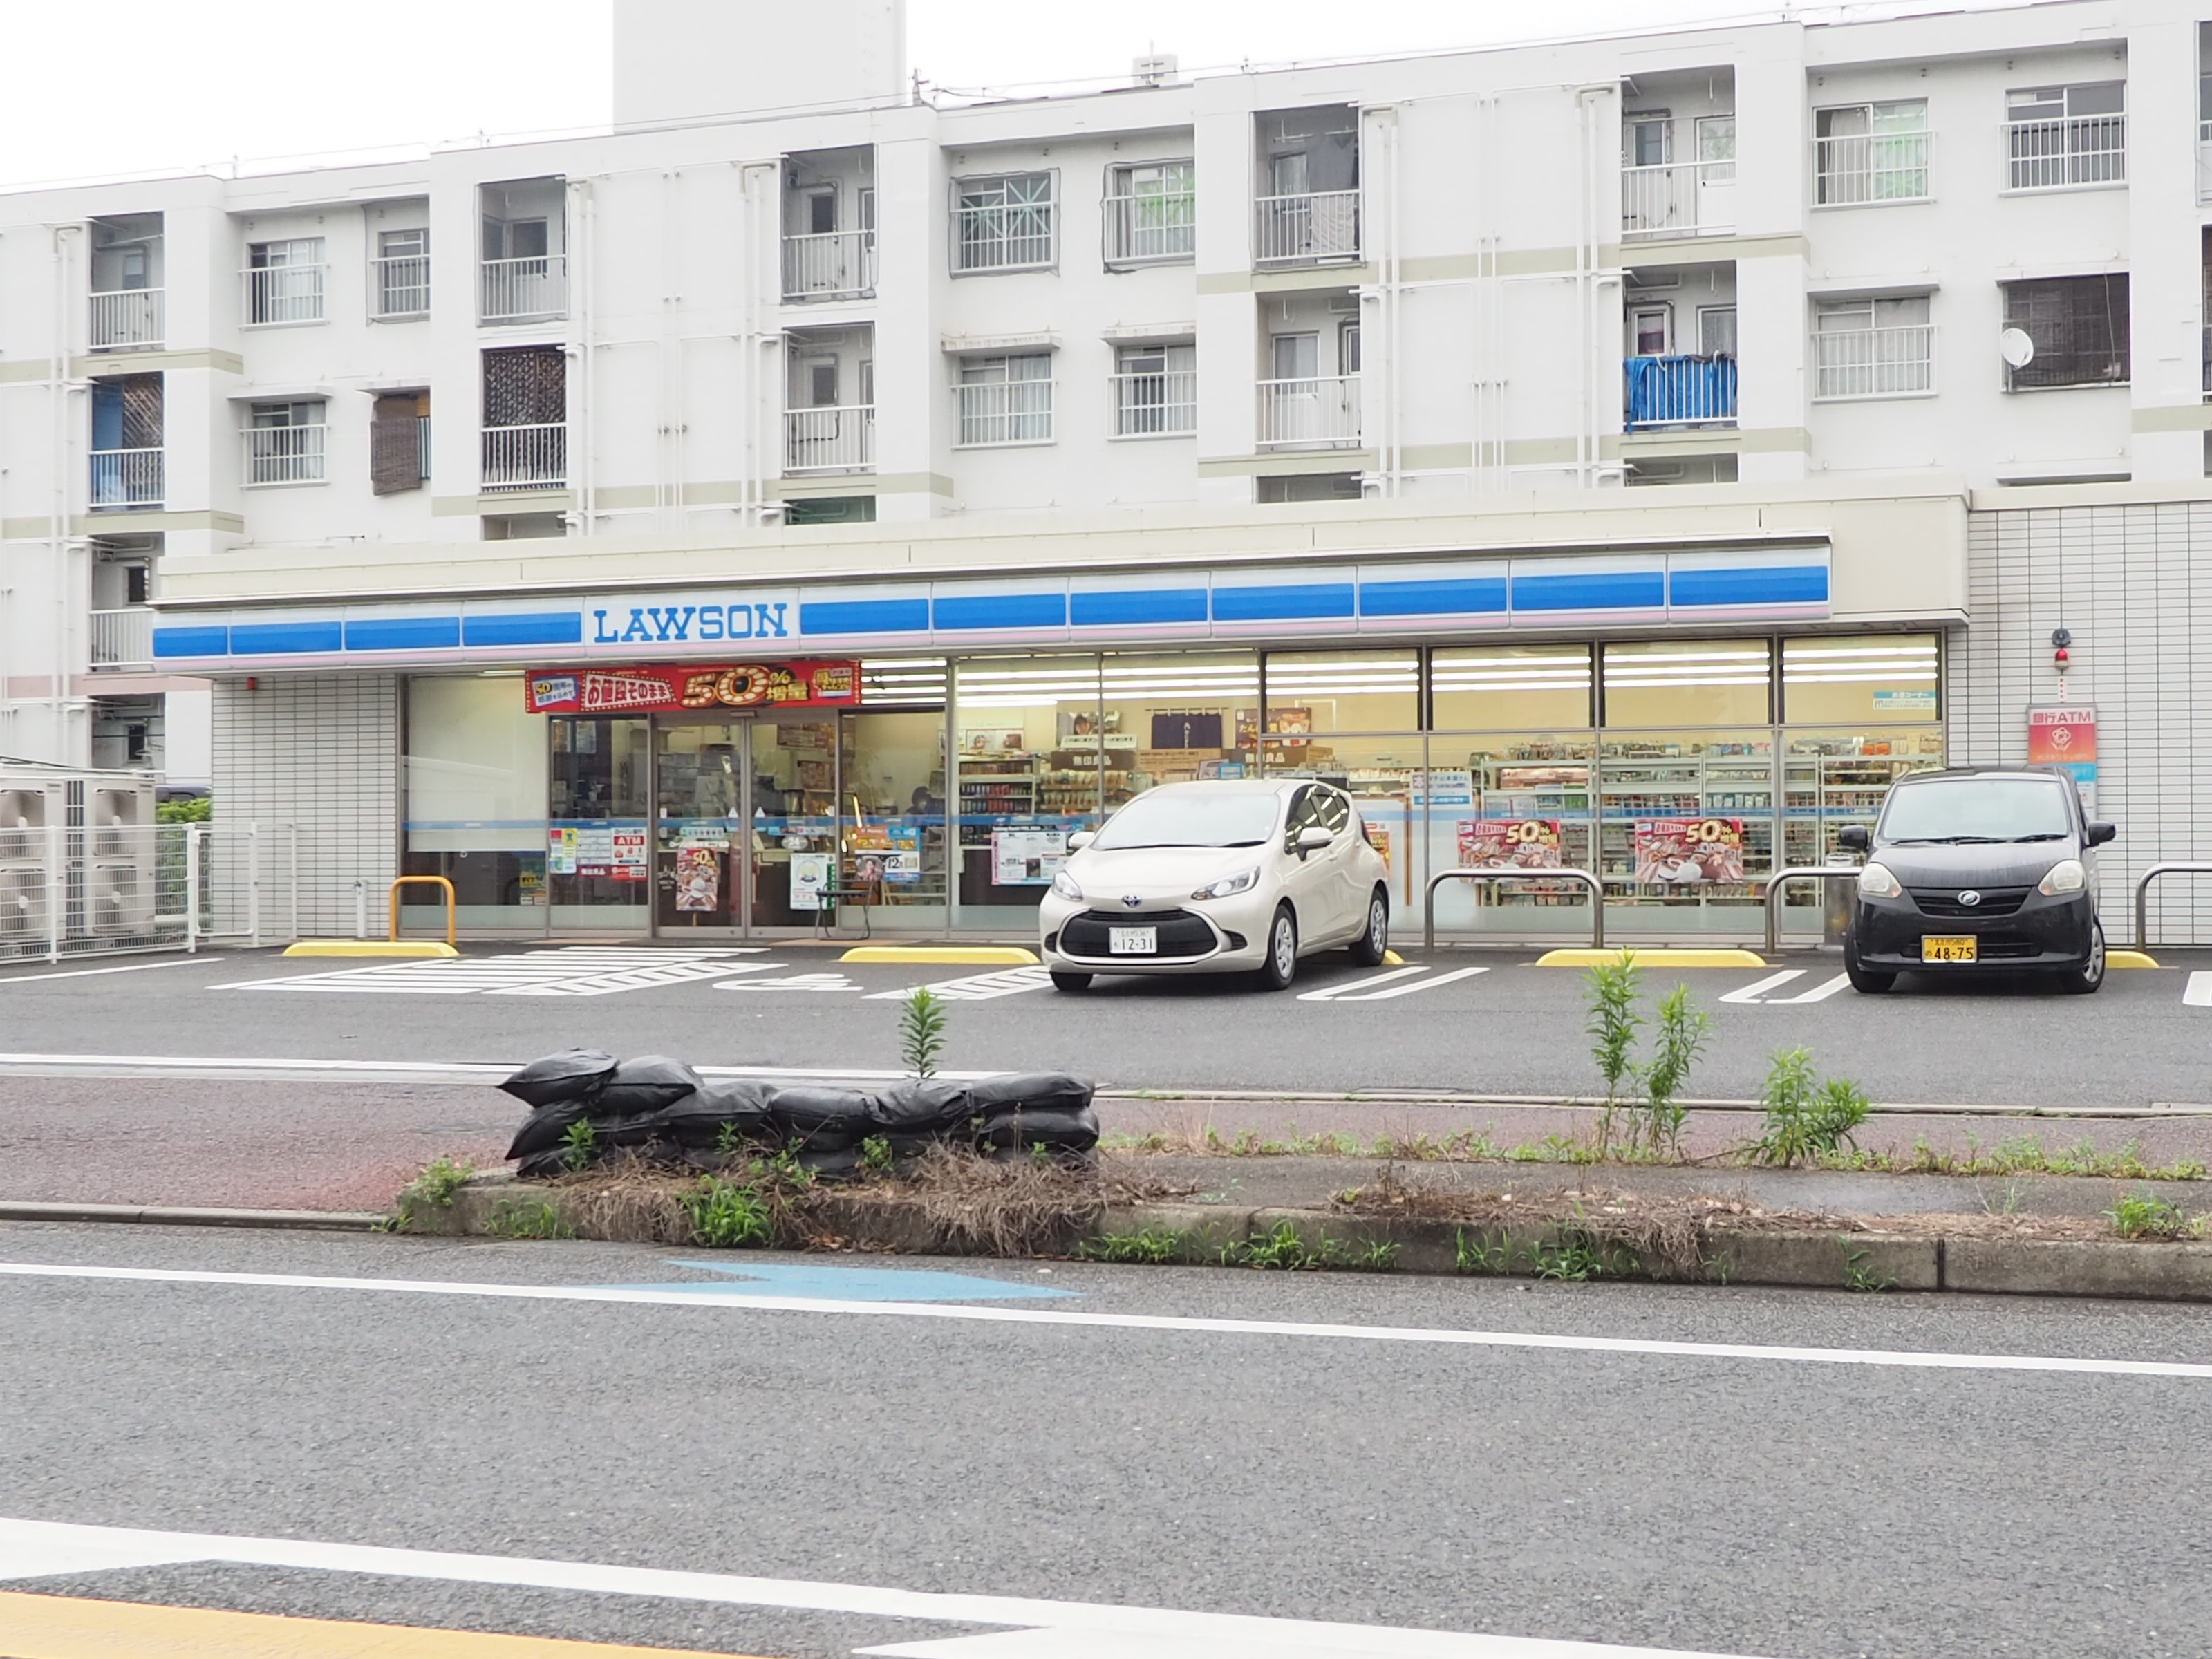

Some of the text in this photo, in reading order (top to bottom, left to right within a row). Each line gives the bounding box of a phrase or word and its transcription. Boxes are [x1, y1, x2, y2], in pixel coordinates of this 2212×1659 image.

[594, 603, 787, 642] LAWSON
[588, 677, 668, 705] お値段そのまま
[2033, 711, 2091, 724] 銀行ATM
[618, 836, 641, 845] ATM
[1122, 938, 1152, 950] 12-31
[1935, 947, 1974, 960] 48-75
